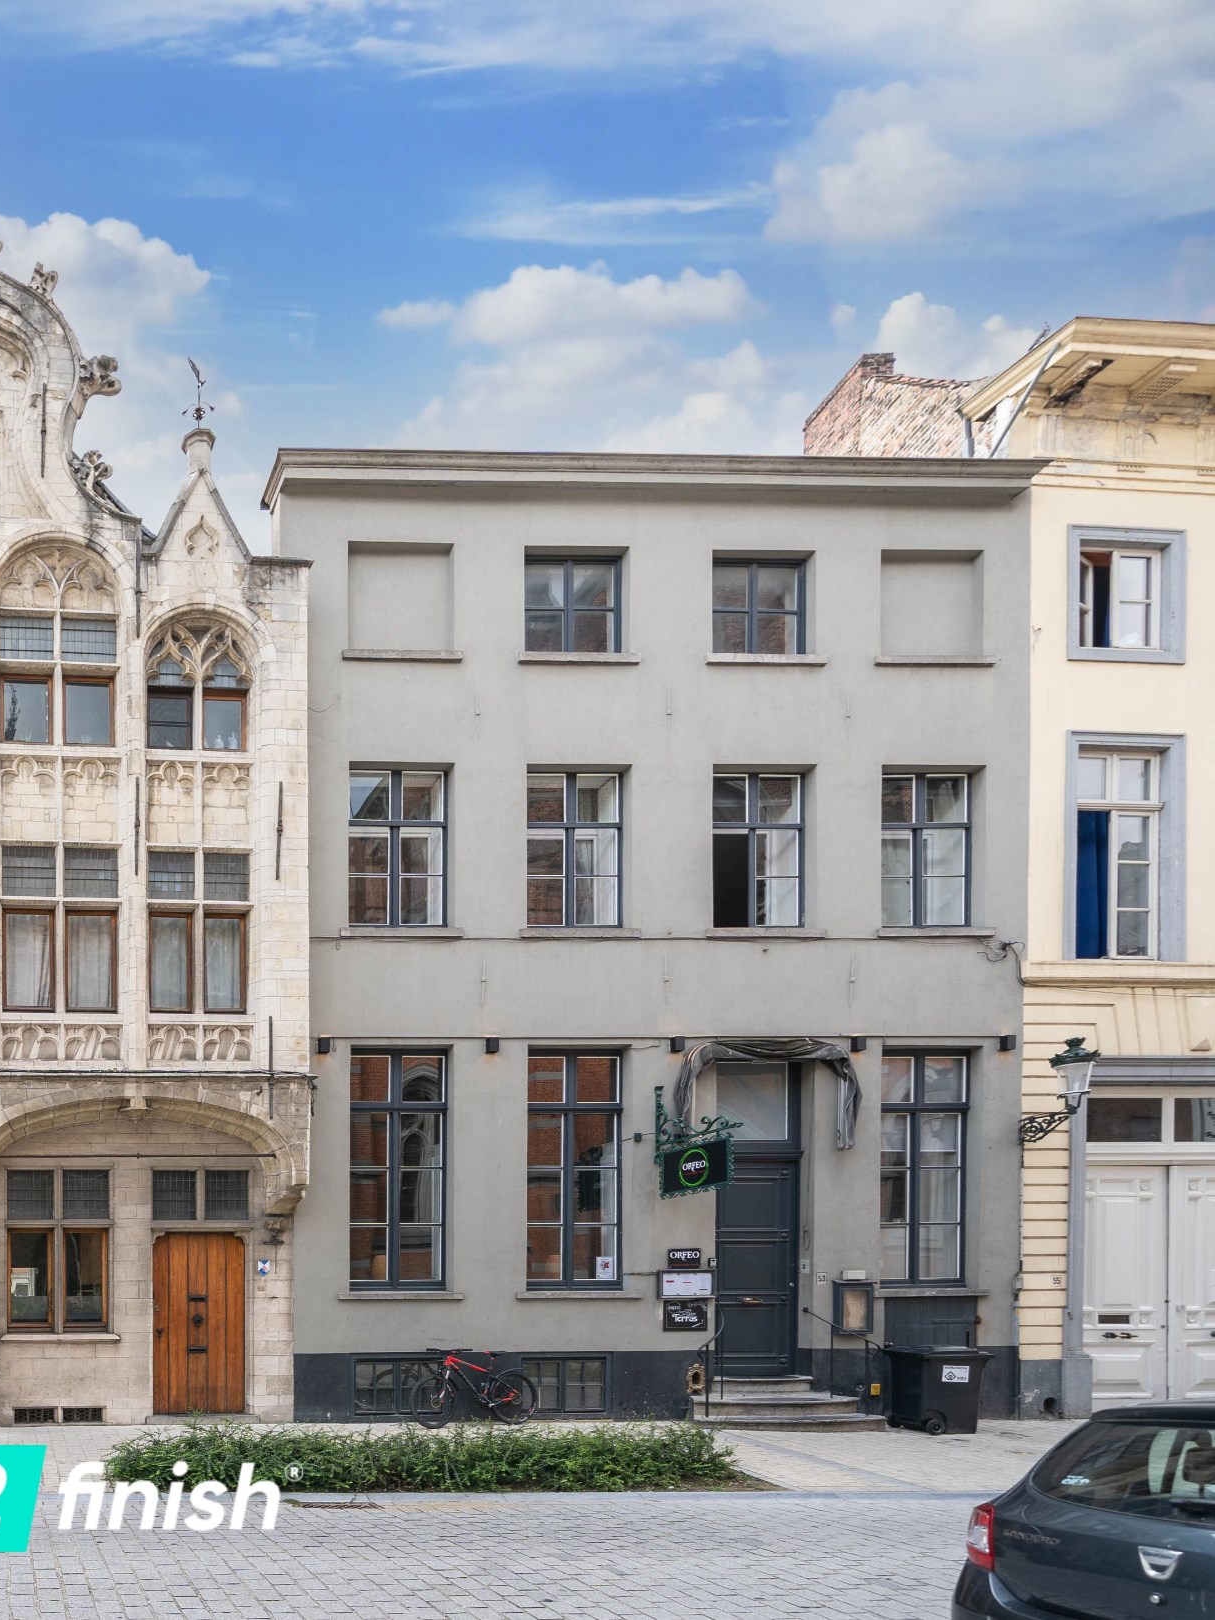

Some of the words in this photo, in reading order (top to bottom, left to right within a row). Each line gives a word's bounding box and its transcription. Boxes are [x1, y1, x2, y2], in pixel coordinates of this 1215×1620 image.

[682, 1160, 706, 1172] ORFEO
[669, 1251, 700, 1261] ORFEO
[817, 1274, 826, 1283] 53
[1052, 1276, 1061, 1285] 55
[671, 1313, 698, 1322] Terras
[1001, 1529, 1061, 1545] SANDERO
